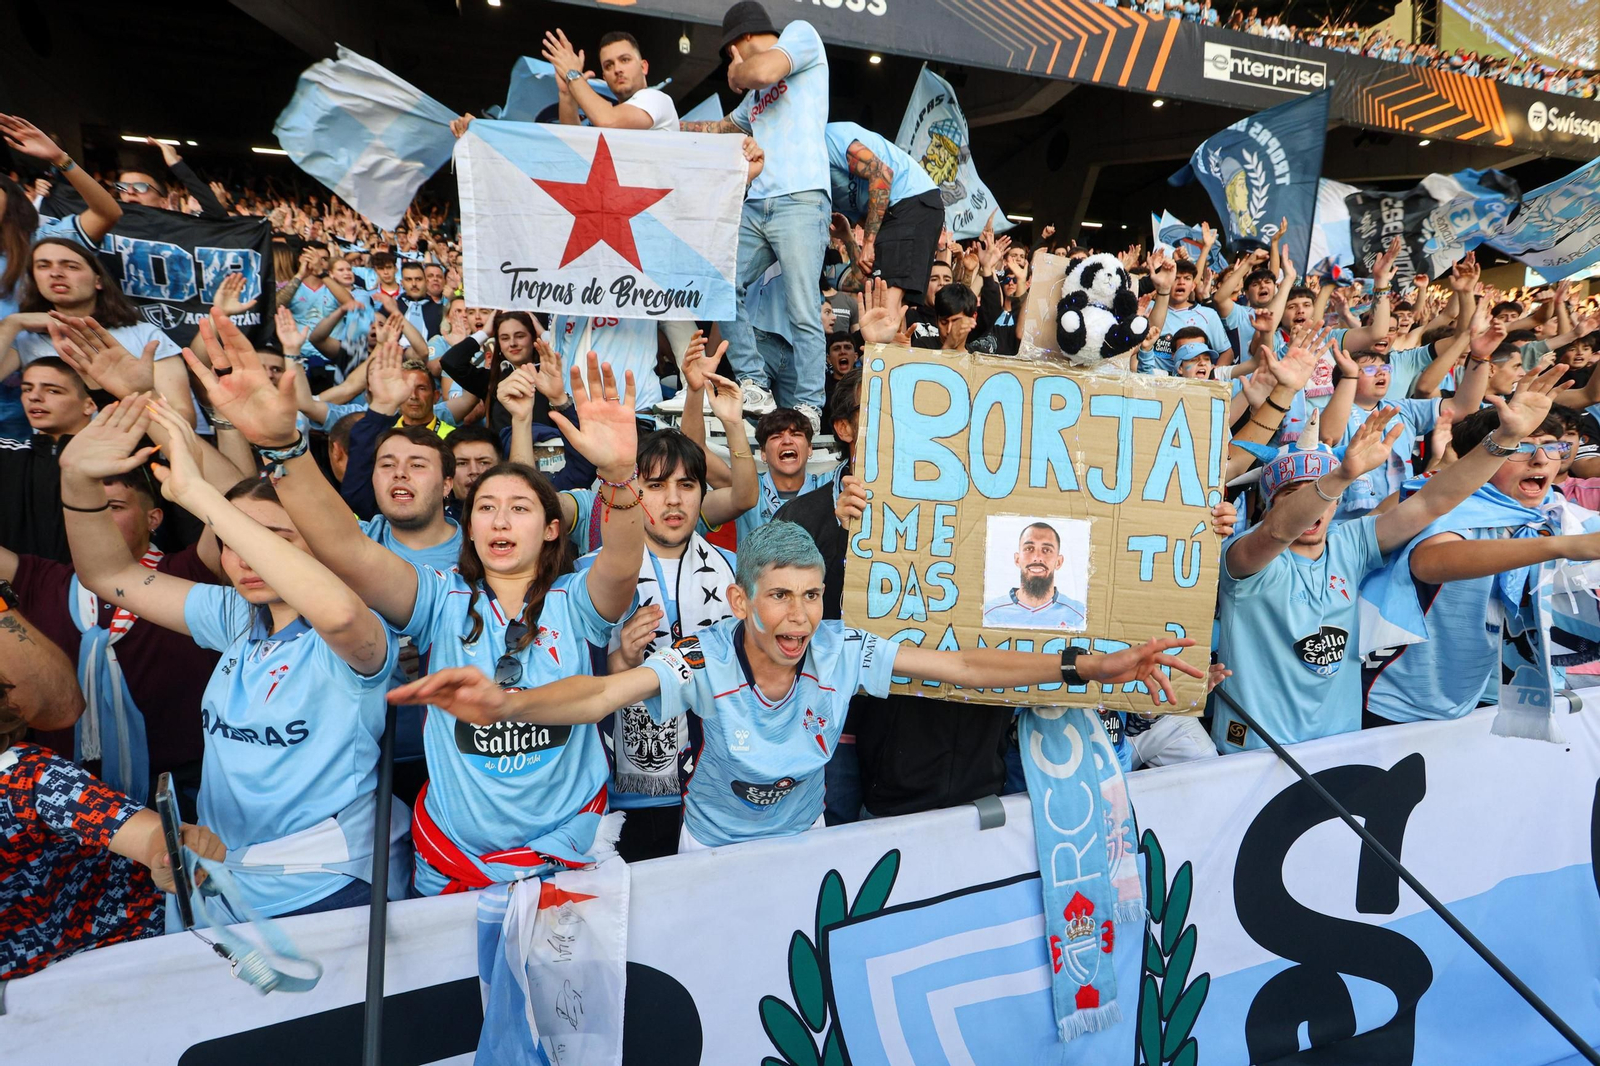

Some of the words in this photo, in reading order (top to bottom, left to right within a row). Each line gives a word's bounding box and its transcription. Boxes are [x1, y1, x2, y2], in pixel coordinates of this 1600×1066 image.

[1211, 53, 1325, 88] enterprise
[1547, 106, 1600, 144] Swissq
[500, 260, 576, 308] Tropas
[581, 277, 605, 306] de
[609, 274, 704, 316] Breogán
[863, 358, 1226, 508] ¡BORJA!
[850, 488, 958, 559] ¿ME
[1126, 520, 1202, 589] TÚ
[866, 560, 960, 622] DAS
[473, 725, 552, 754] Galicia
[497, 752, 527, 774] 0,0
